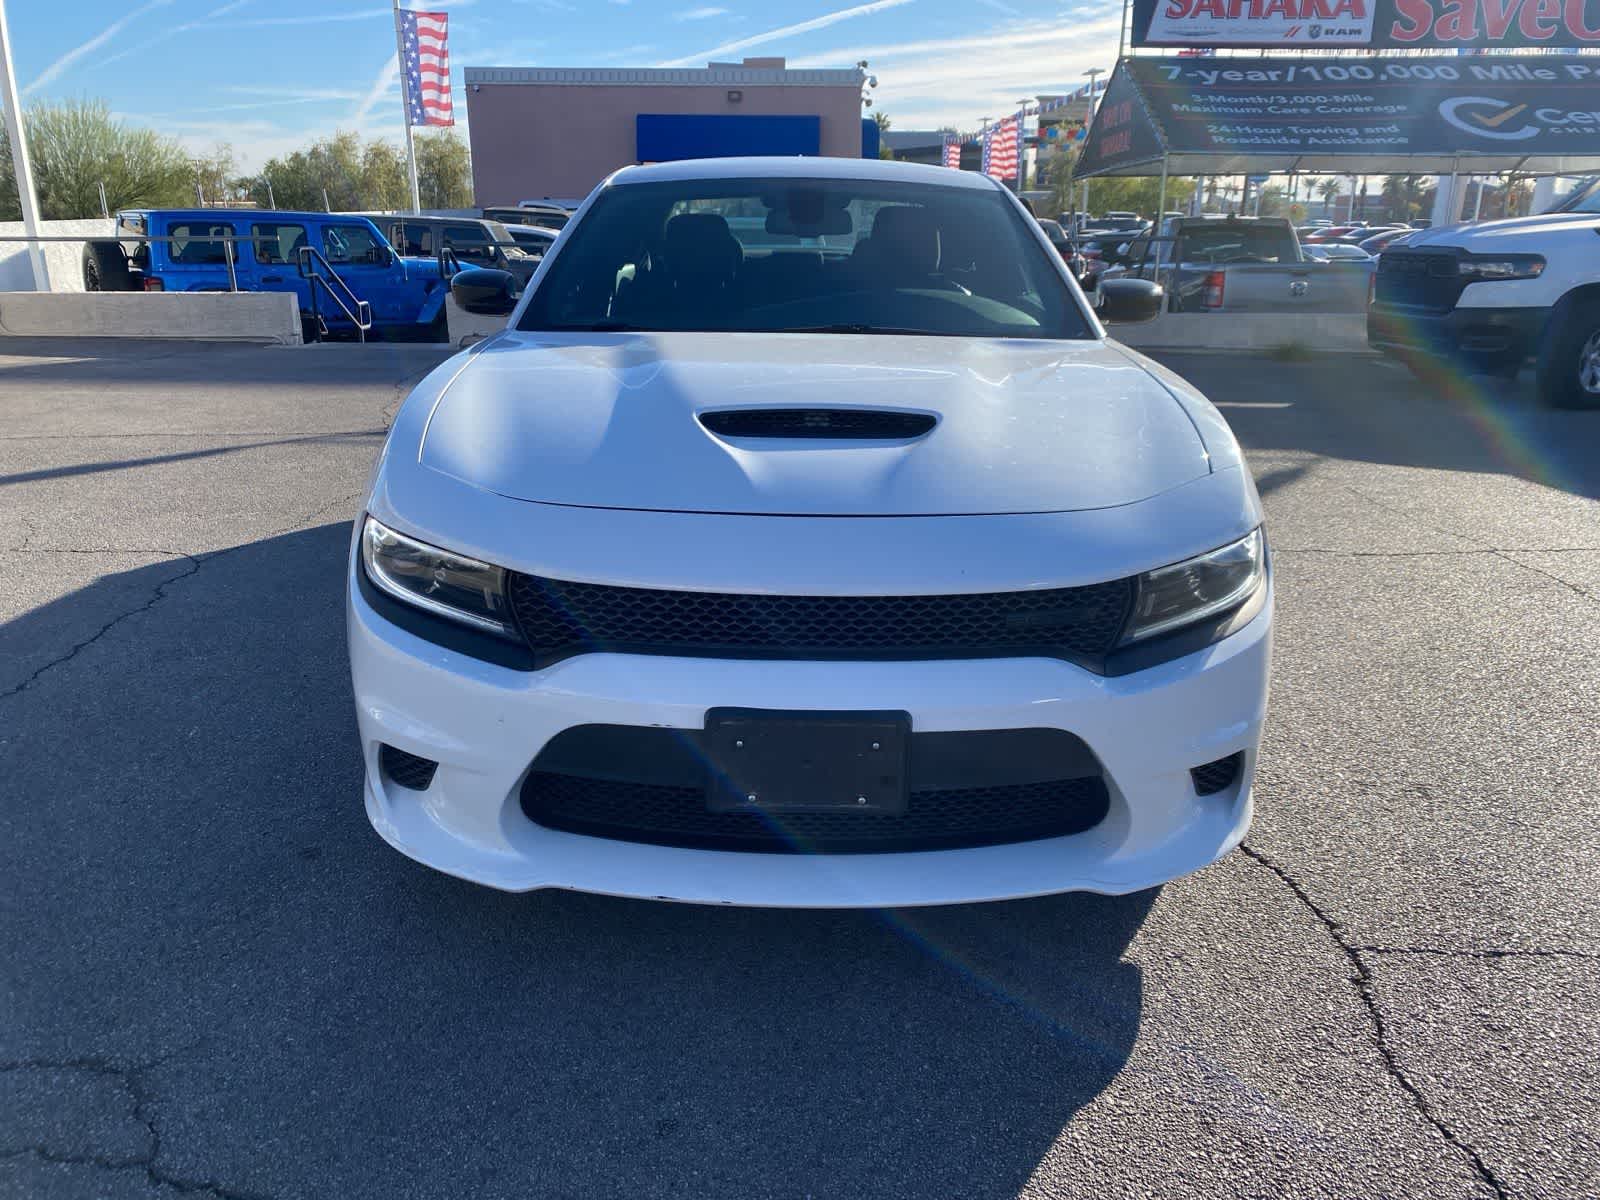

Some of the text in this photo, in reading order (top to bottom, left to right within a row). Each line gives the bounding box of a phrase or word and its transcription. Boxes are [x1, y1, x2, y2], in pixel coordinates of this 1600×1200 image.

[1324, 28, 1362, 36] RAM
[1159, 64, 1460, 85] 7-year/100,000
[1468, 63, 1558, 81] Mile
[1191, 94, 1375, 105] 3-Month/3,000-Mile
[1171, 103, 1407, 115] Maximum Care Coverage
[1206, 123, 1401, 136] 24-Hour Towing and
[1210, 135, 1409, 145] Roadside Assistance
